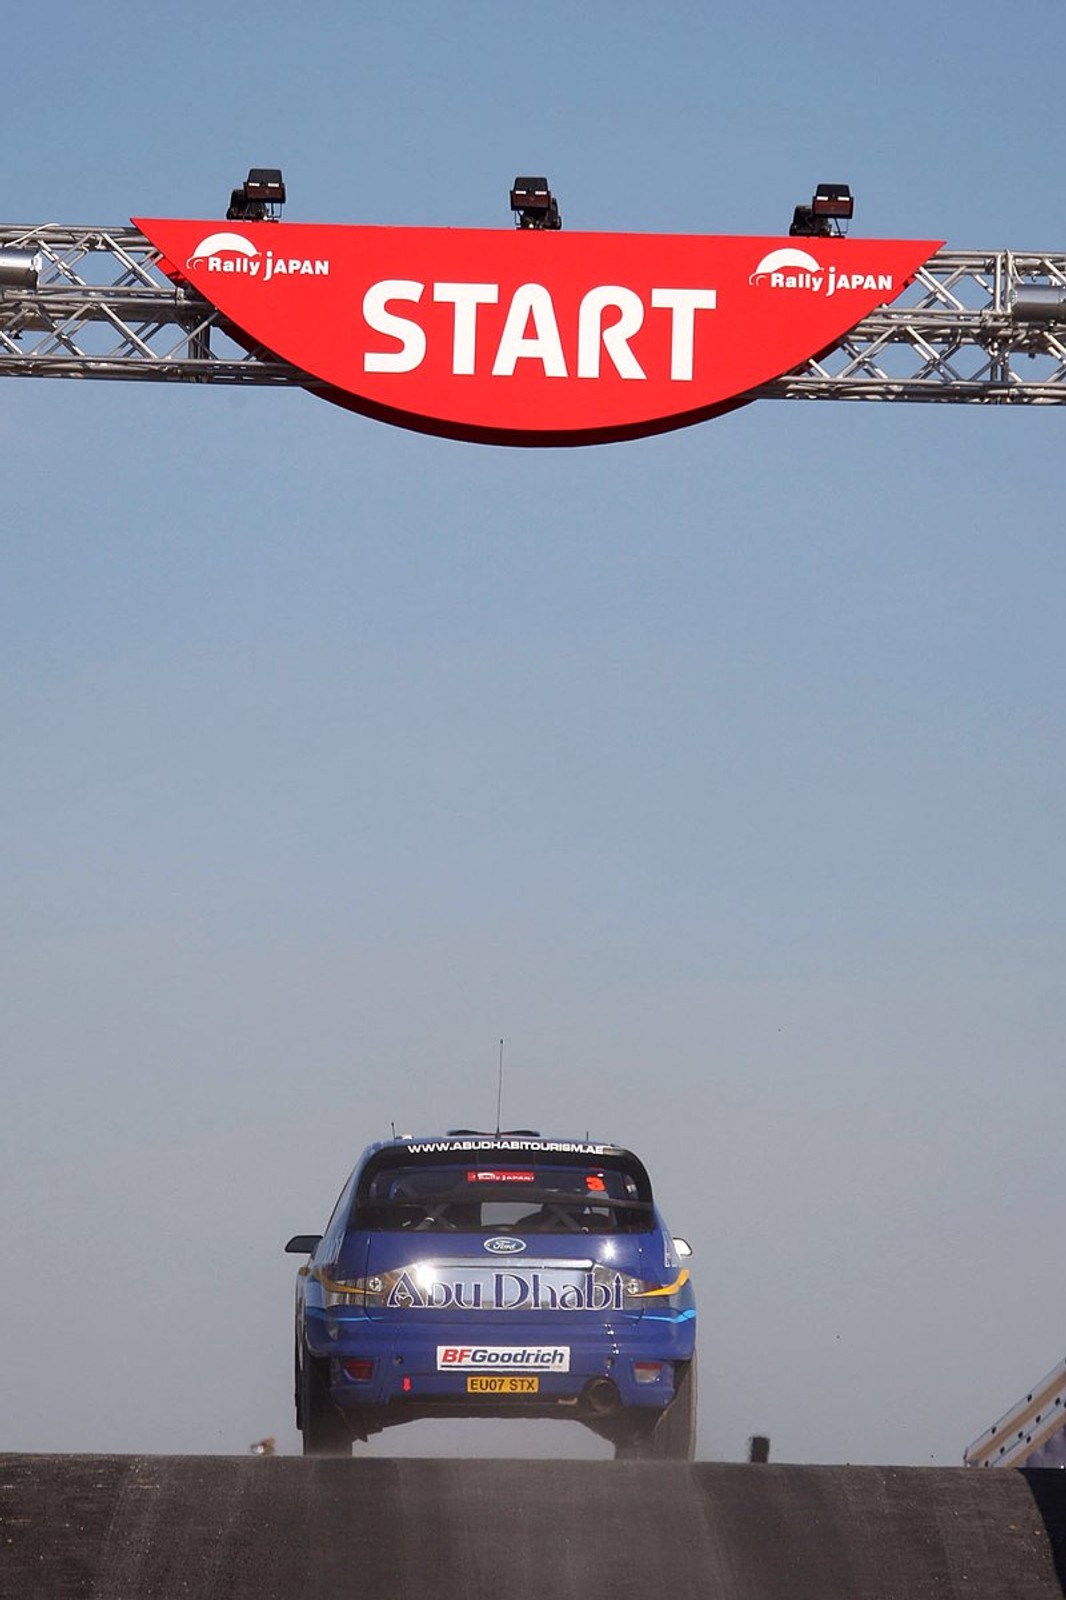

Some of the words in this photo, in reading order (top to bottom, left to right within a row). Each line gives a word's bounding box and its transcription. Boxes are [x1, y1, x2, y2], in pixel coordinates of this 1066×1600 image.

[208, 257, 260, 275] Rally
[770, 273, 823, 292] Rally
[363, 280, 717, 382] START
[407, 1140, 604, 1155] WWW.ABUDHABITOURISM.AE
[491, 1272, 624, 1311] Dhabi
[442, 1348, 565, 1364] BFGoodrich
[470, 1379, 505, 1391] EU07
[509, 1379, 535, 1391] STX
